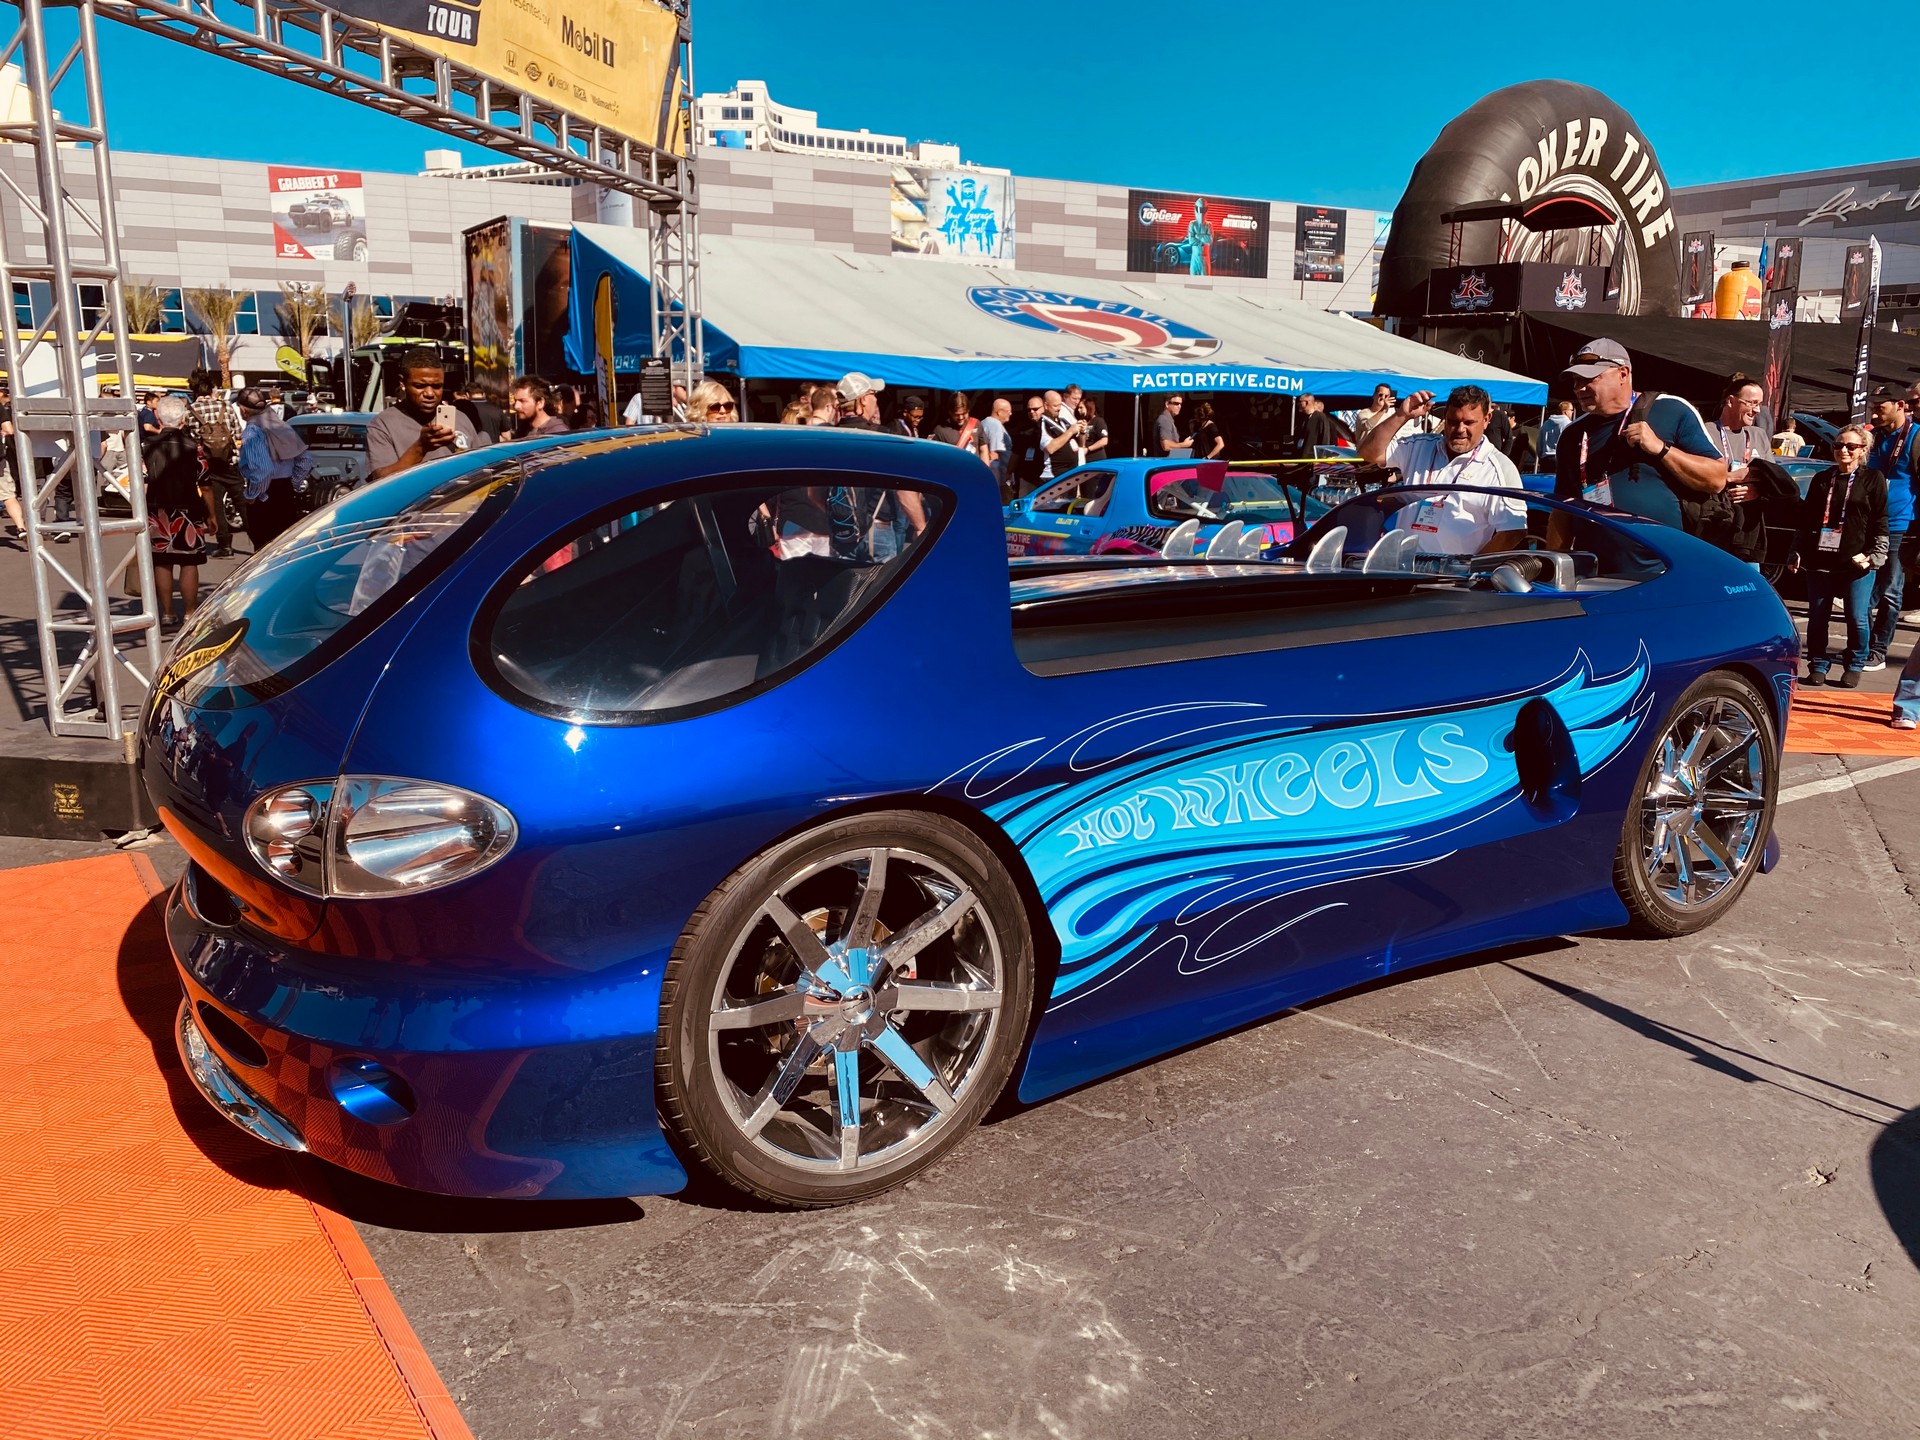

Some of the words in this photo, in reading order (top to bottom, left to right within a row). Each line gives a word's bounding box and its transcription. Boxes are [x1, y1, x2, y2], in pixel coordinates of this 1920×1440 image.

[428, 4, 472, 40] TOUR
[562, 15, 599, 61] Mobil
[603, 37, 615, 67] 1
[278, 176, 325, 191] GRABBER
[1500, 117, 1608, 202] OKER
[1610, 131, 1675, 249] TIRE
[1798, 187, 1906, 227] Las
[1132, 372, 1303, 391] FACTORYFIVE.COM
[1724, 584, 1751, 595] Deora
[1746, 689, 1766, 716] TOYO
[1057, 790, 1157, 857] HOT
[1137, 723, 1488, 830] WHEELS
